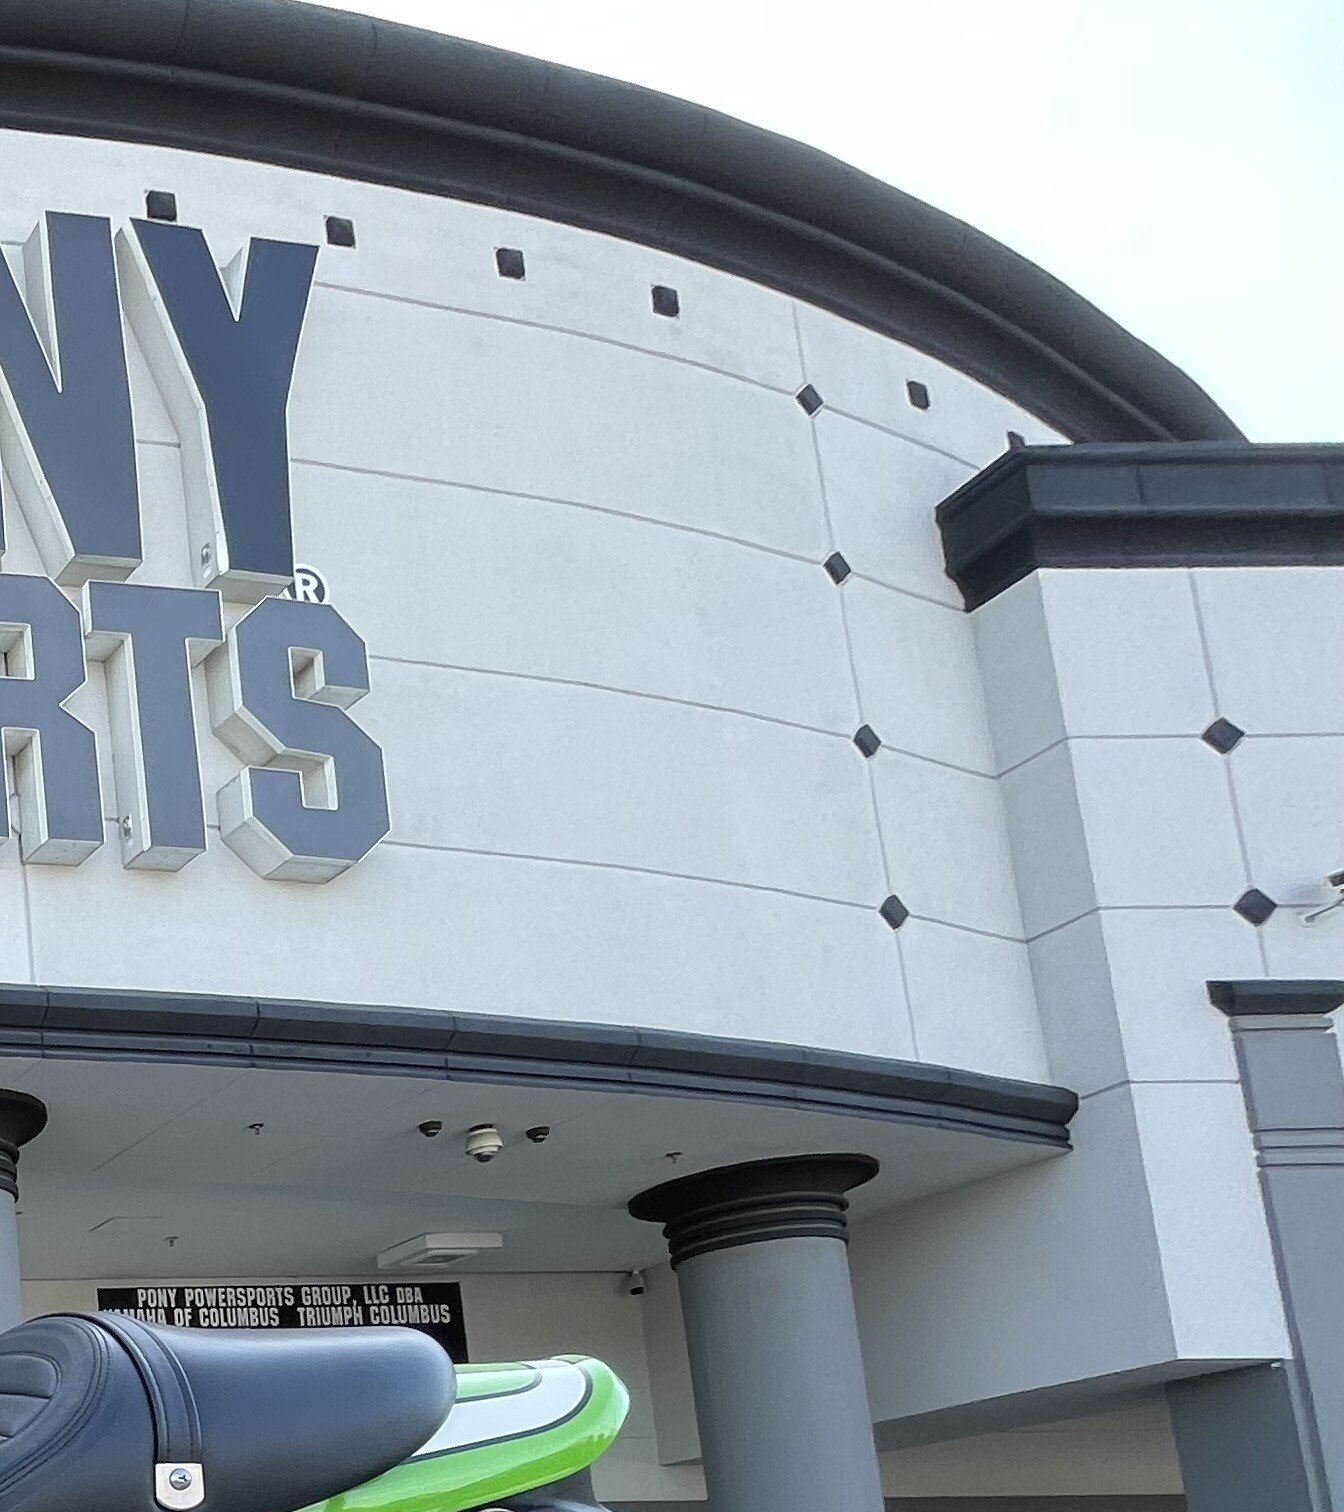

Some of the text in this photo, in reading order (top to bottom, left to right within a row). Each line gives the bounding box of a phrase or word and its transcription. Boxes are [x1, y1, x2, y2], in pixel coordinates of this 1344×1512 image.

[137, 1284, 424, 1307] PONY POWERSPORTS GROUP, LLC DBA
[102, 1304, 451, 1327] AHA OF COLUMBUS TRIUMPH COLUMBUS
